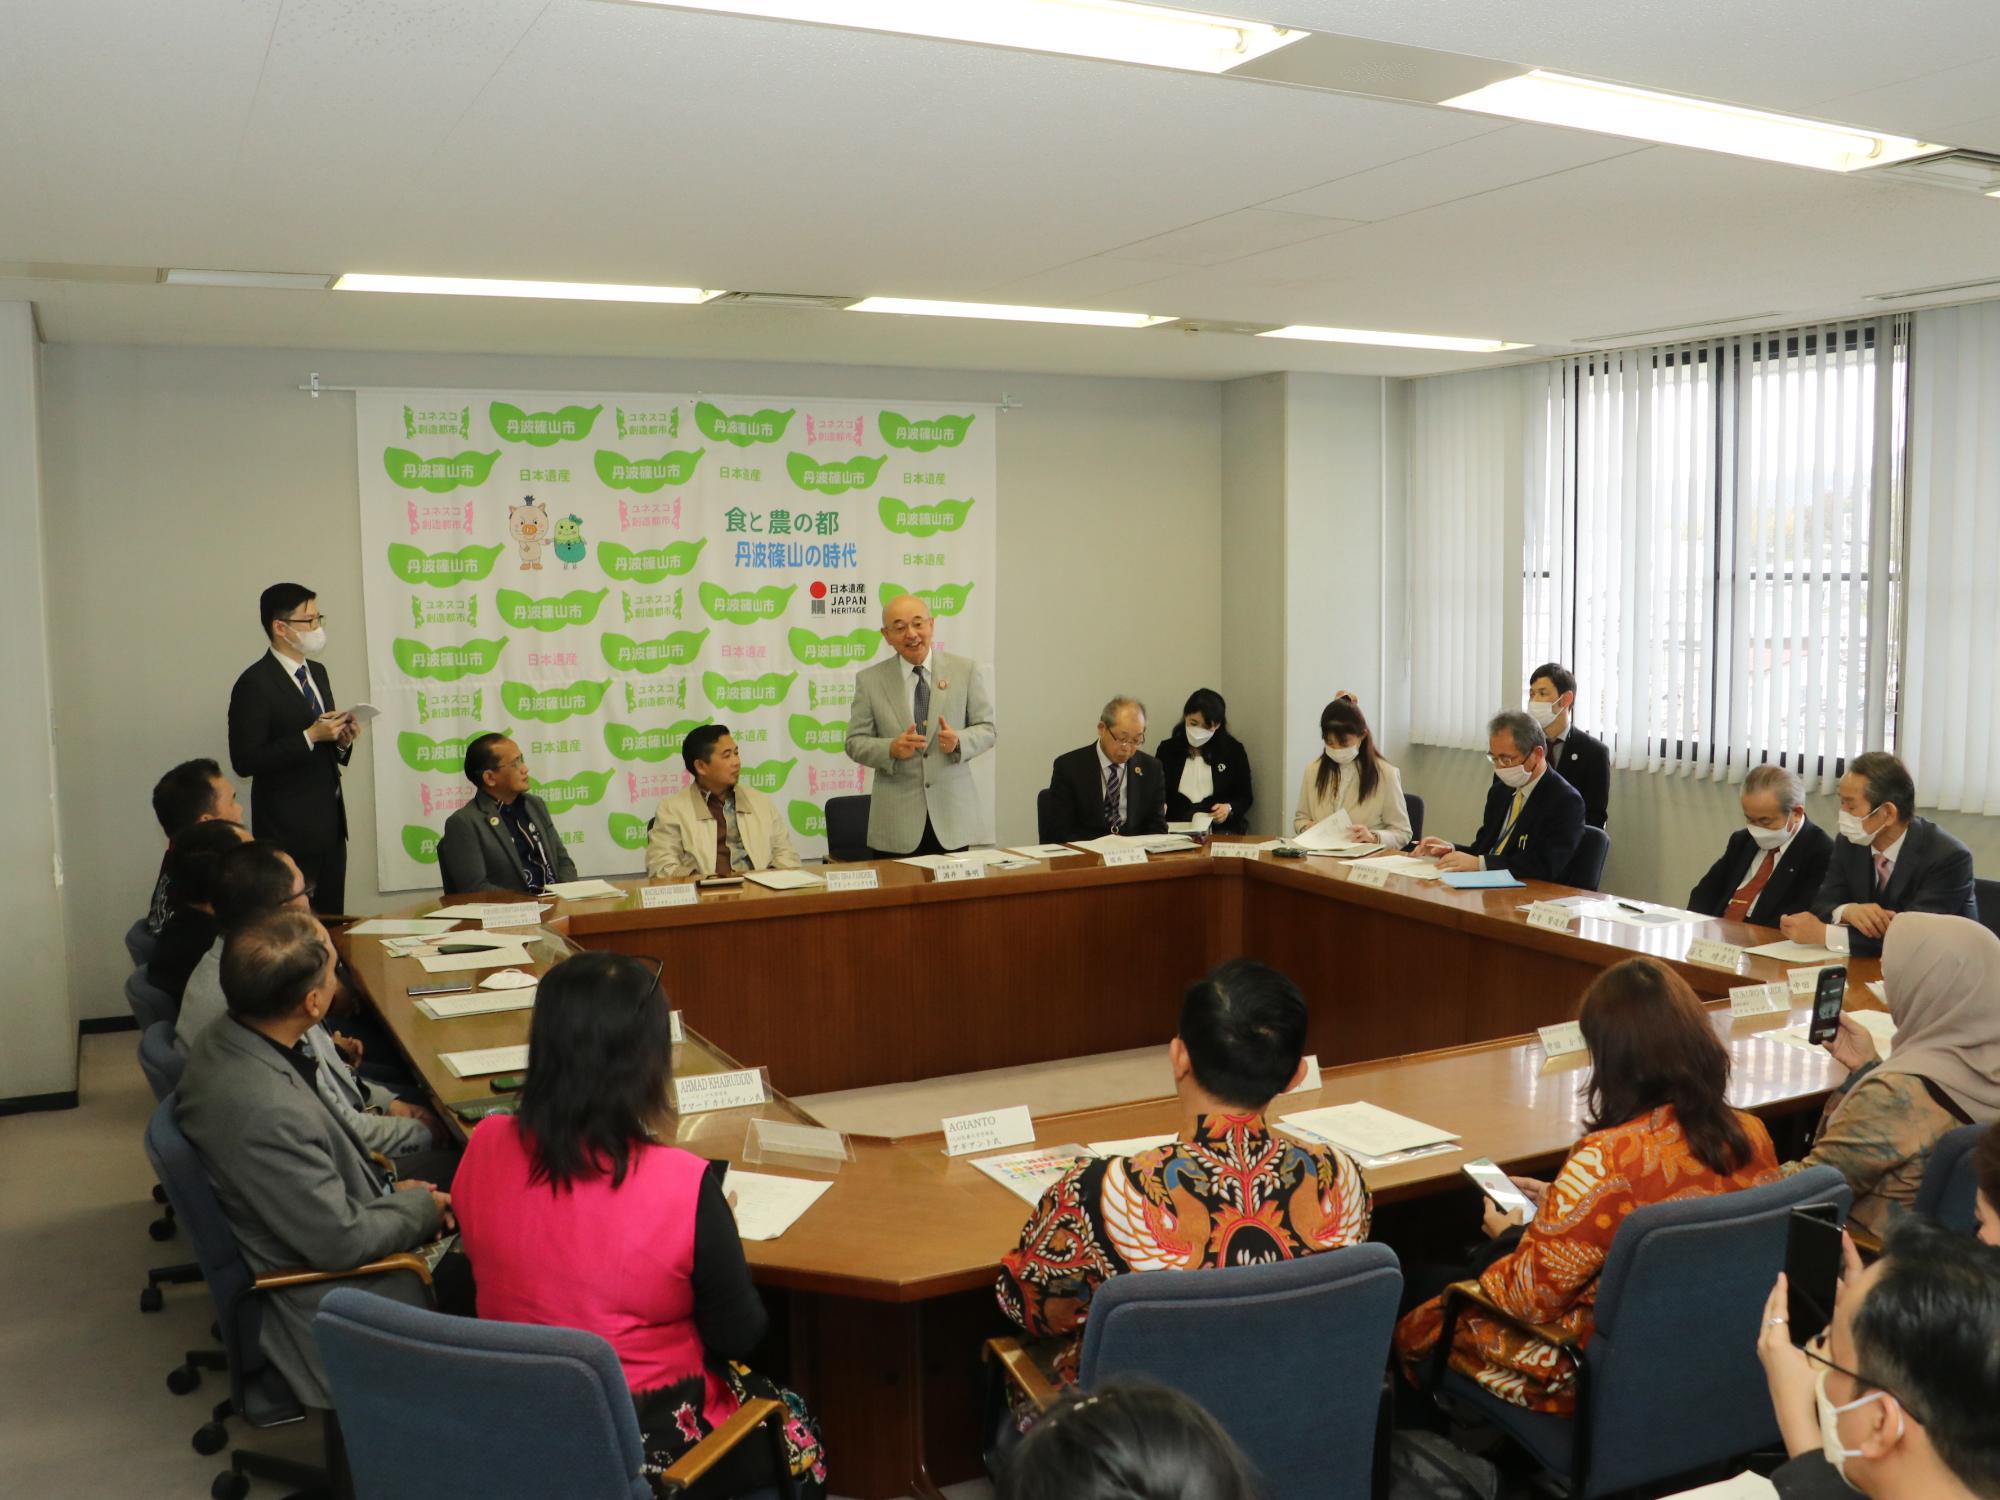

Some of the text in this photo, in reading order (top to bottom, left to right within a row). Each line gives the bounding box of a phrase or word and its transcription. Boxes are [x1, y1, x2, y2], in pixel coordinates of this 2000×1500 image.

[418, 411, 458, 421] ユネスコ
[629, 412, 667, 422] ユネスコ
[507, 419, 576, 435] 丹波篠山市
[896, 427, 955, 441] 丹波篠山市
[403, 463, 474, 479] 丹波篠山市
[520, 468, 570, 482] 日本遺産
[612, 464, 681, 480] 丹波篠山市
[803, 470, 865, 485] 丹波篠山市
[903, 472, 945, 485] 日本遺産
[724, 506, 839, 535] 食と農の都
[896, 512, 954, 526] 丹波篠山市
[735, 540, 857, 569] 丹波篠山の時代
[903, 553, 945, 566] 日本遺産
[407, 558, 478, 574] 丹波篠山市
[615, 555, 681, 572] 丹波篠山市
[830, 583, 866, 594] 日本遺産
[714, 598, 774, 613] 丹波篠山市
[831, 596, 867, 607] JAPAN
[514, 604, 582, 619] 丹波篠山市
[831, 606, 867, 615] HERITAGE
[619, 643, 684, 661] 丹波篠山市
[805, 644, 866, 658] 丹波篠山市
[412, 652, 483, 667] 丹波篠山市
[528, 652, 577, 666] 日本遺産
[716, 686, 776, 701] 丹波篠山市
[518, 695, 585, 711] 丹波篠山市
[733, 728, 768, 743] 本遺産
[805, 729, 847, 745] 丹波篠
[531, 740, 582, 754] 日本遺産
[681, 1077, 707, 1094] AHMAD
[949, 1116, 996, 1132] AGIANTO
